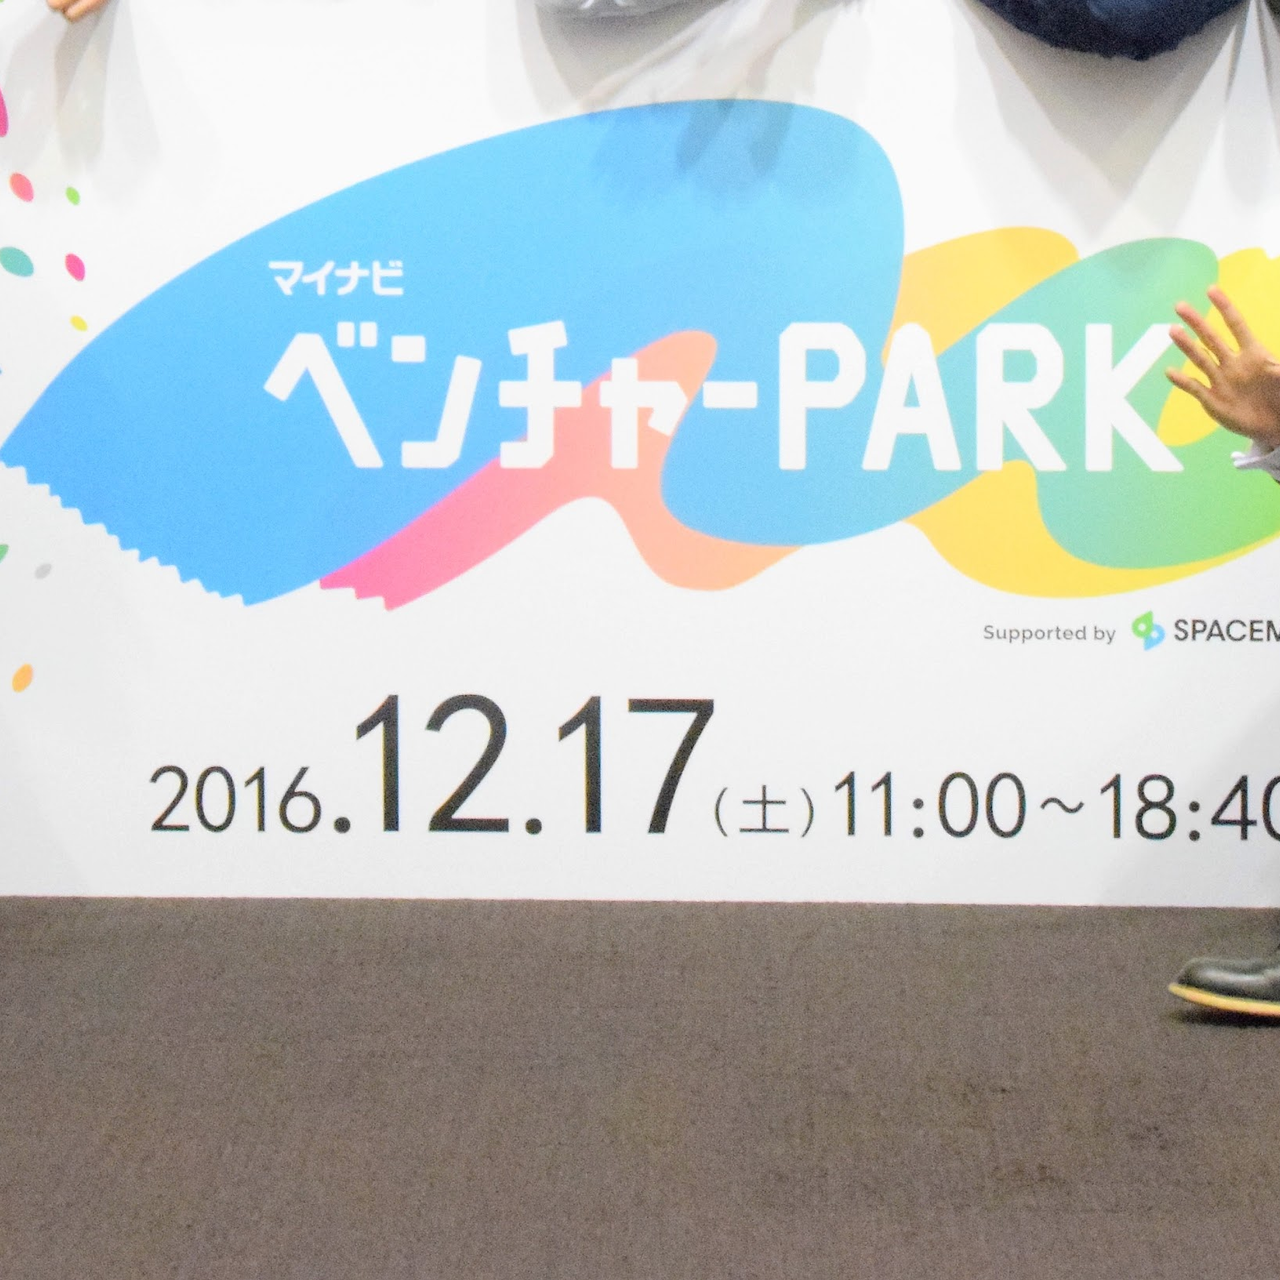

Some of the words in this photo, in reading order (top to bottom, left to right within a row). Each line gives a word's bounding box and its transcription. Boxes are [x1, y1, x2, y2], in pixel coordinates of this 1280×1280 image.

[269, 260, 403, 295] マイナビ
[983, 624, 1088, 645] Supported
[1093, 624, 1117, 646] by
